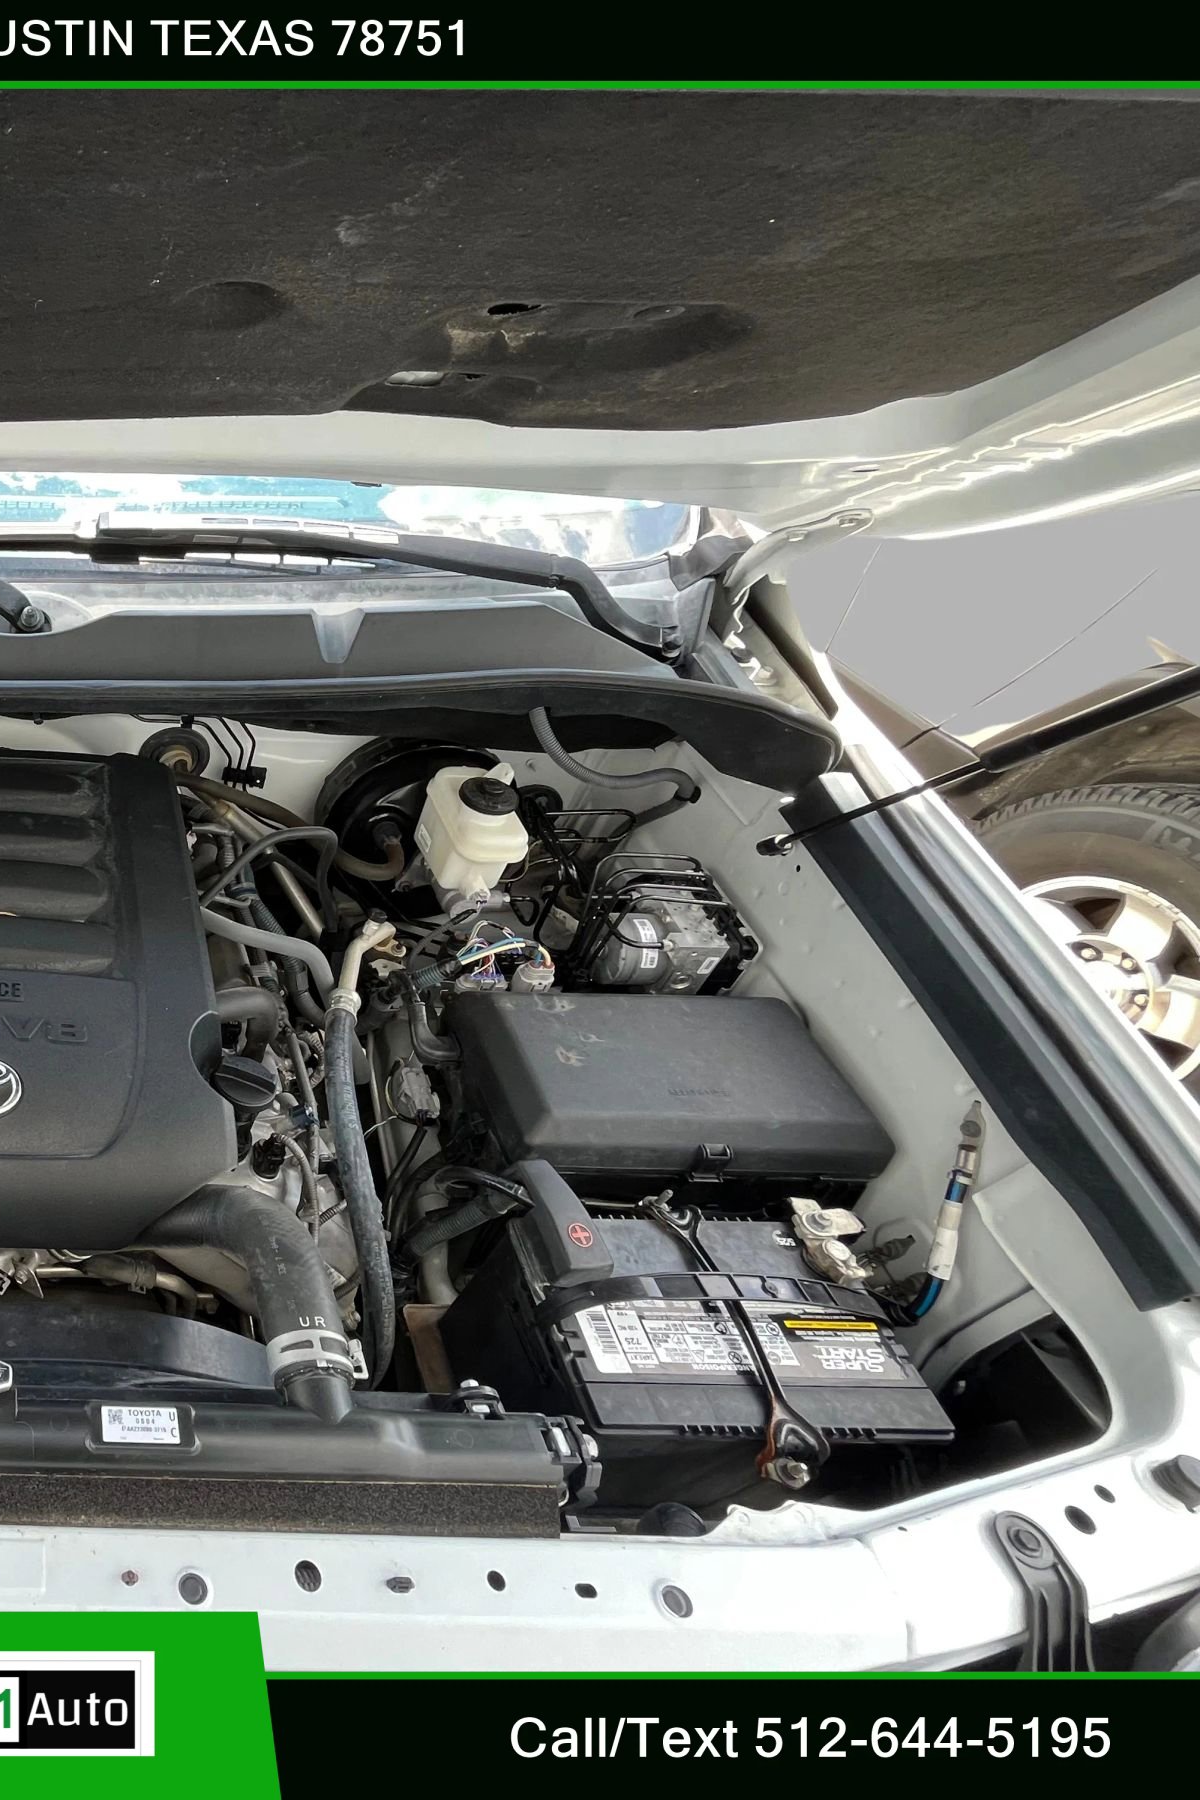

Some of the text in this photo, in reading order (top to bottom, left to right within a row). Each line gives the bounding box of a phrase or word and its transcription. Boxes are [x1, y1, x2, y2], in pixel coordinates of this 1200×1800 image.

[0, 1014, 89, 1044] V8
[814, 1345, 886, 1363] START
[819, 1356, 884, 1373] SUPER
[127, 1409, 176, 1422] TOYOTA U
